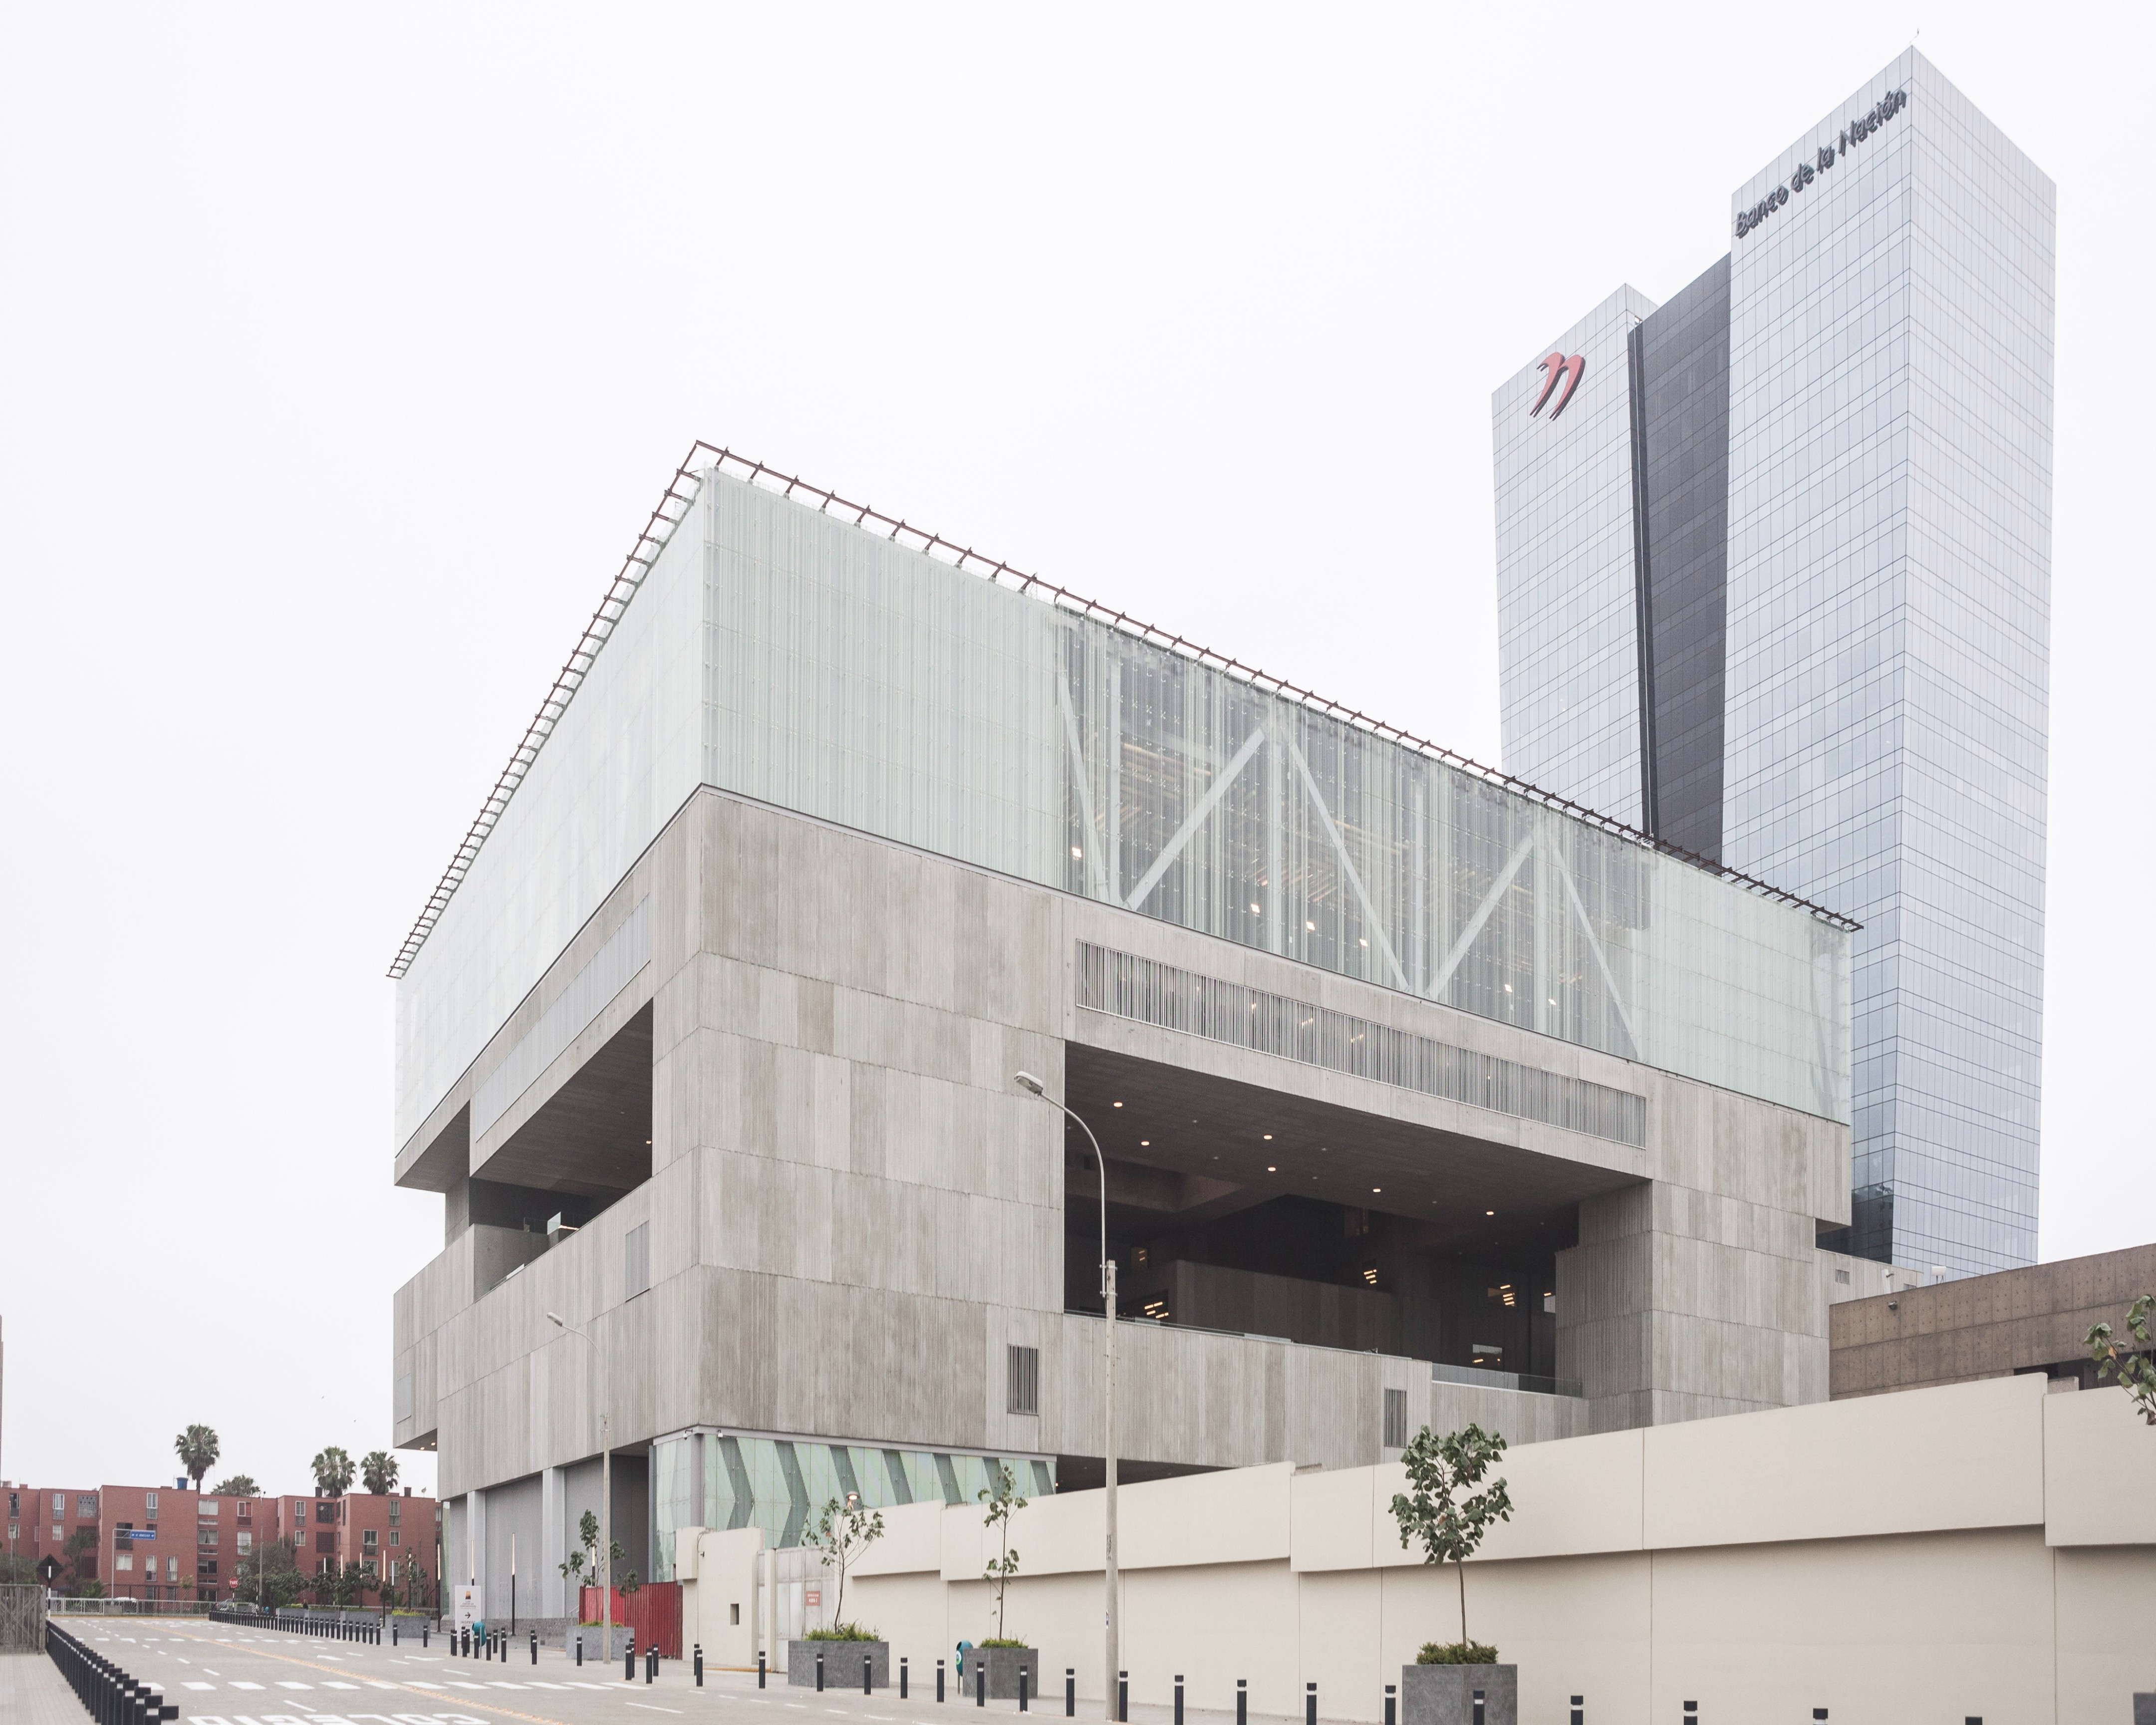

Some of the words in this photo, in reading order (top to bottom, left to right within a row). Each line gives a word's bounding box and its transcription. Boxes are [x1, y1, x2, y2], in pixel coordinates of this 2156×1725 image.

[1736, 185, 1789, 239] Banco
[1791, 163, 1814, 193] de
[1817, 146, 1835, 174] la
[1839, 89, 1906, 157] Nación
